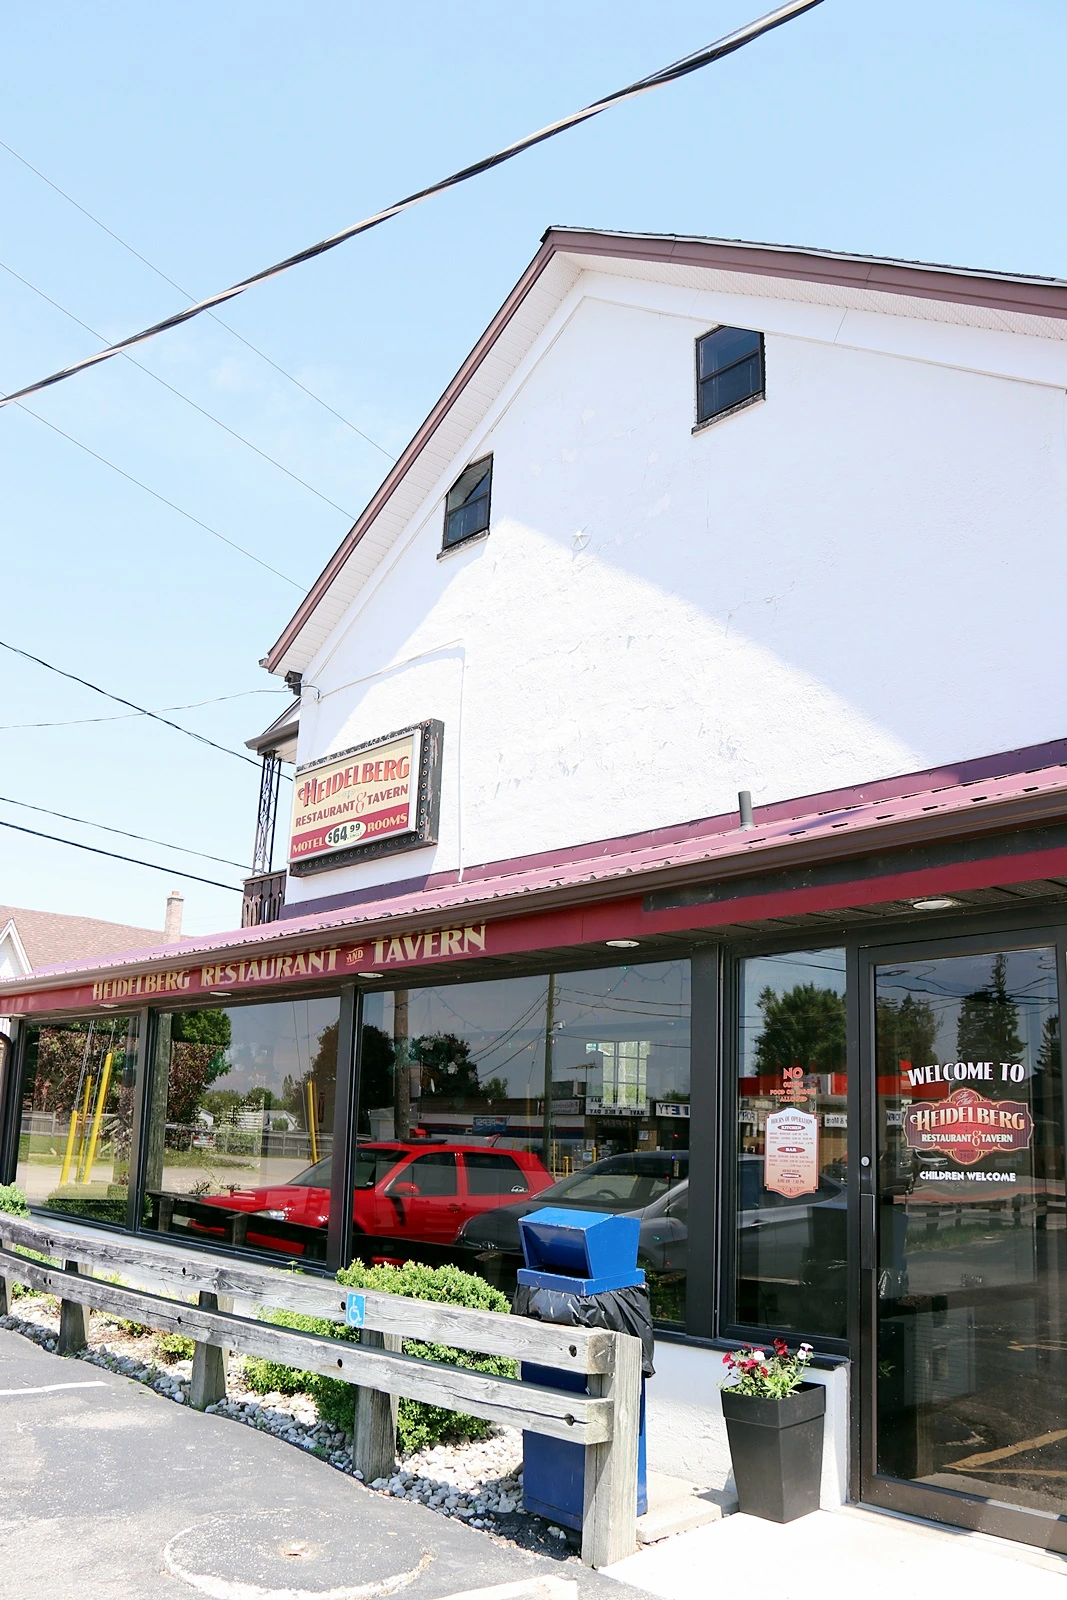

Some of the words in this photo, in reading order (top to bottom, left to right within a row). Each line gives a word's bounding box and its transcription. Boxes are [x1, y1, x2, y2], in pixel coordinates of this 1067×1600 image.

[297, 756, 410, 807] HEIDELBERG
[295, 800, 356, 827] RESTAURANT
[355, 791, 367, 814] &
[367, 783, 409, 806] TAVERN
[292, 836, 325, 853] MOTEL
[367, 812, 408, 833] ROOMS
[92, 970, 190, 1001] HEIDELBERG
[200, 948, 341, 988] RESTAURANT
[346, 949, 364, 964] AND
[371, 925, 487, 966] TAVERN
[783, 1067, 803, 1080] NO
[907, 1062, 993, 1087] WELCOME
[999, 1062, 1025, 1083] TO
[909, 1106, 1025, 1132] HEIDELBERG
[921, 1133, 972, 1143] RESTAURANT
[971, 1130, 982, 1147] &
[981, 1133, 1013, 1143] TAVERN
[919, 1171, 965, 1181] CHILDREN
[966, 1172, 1016, 1182] WELCOME
